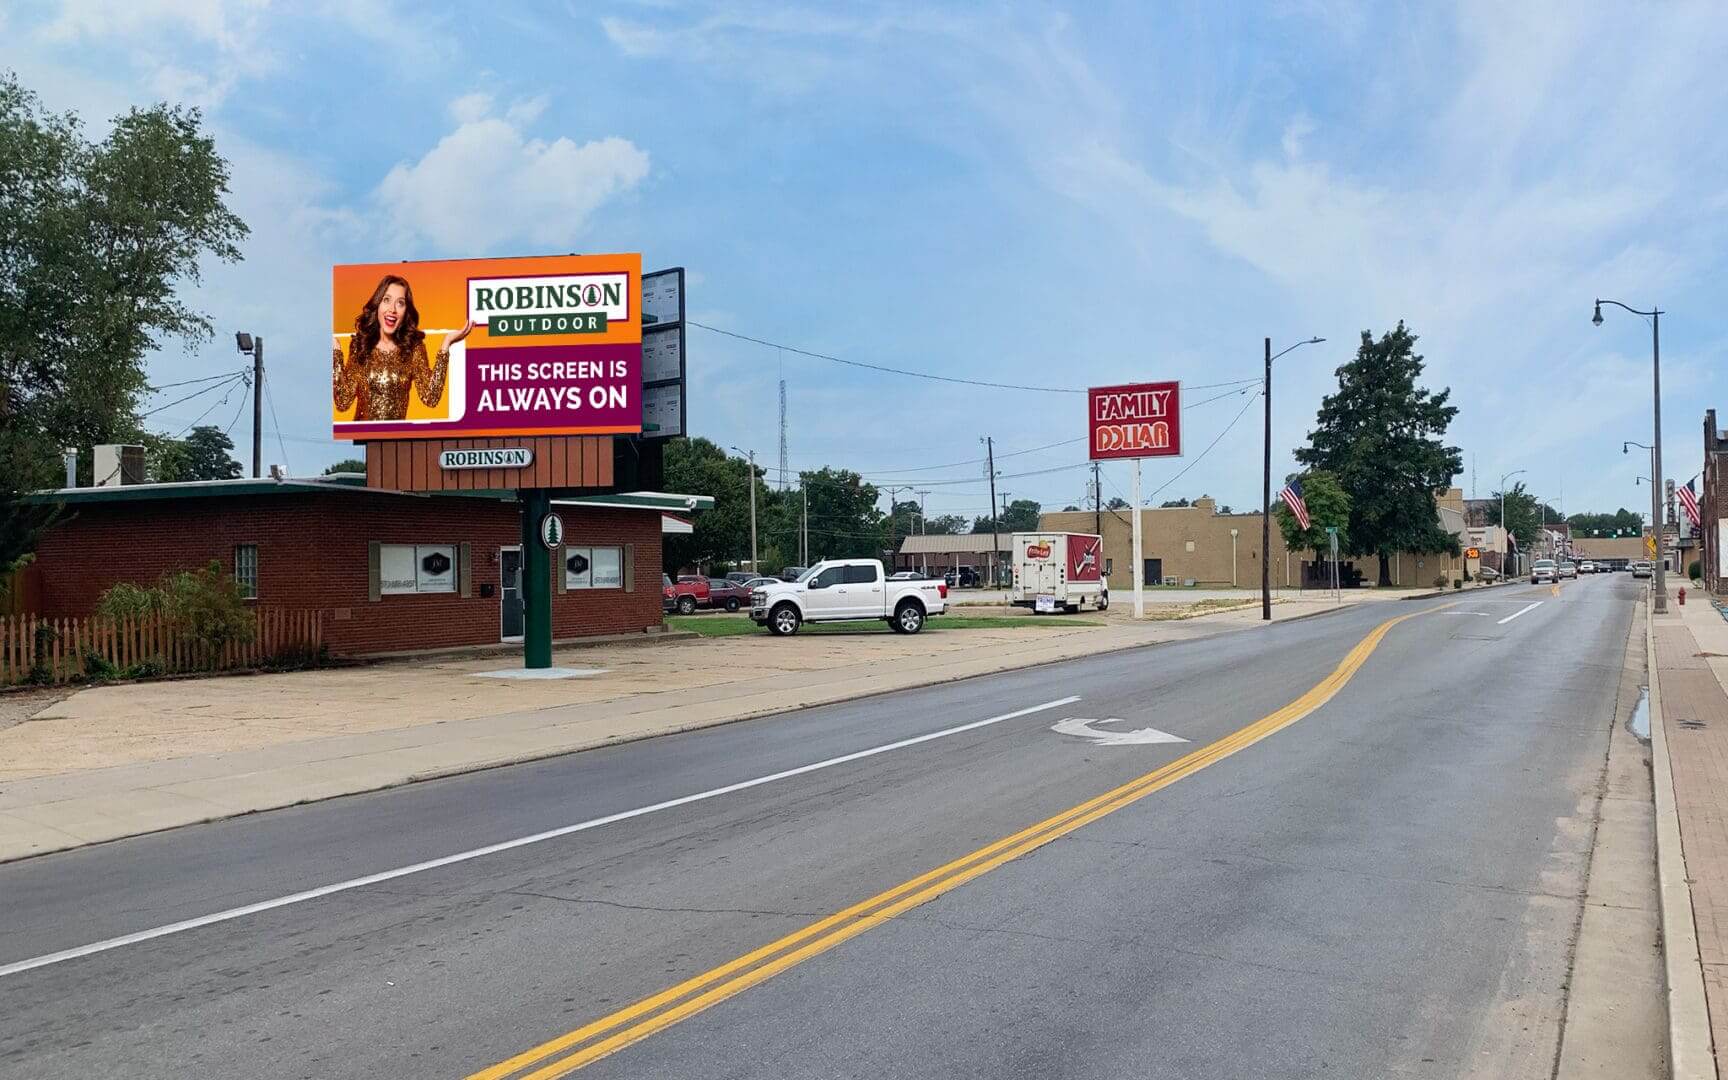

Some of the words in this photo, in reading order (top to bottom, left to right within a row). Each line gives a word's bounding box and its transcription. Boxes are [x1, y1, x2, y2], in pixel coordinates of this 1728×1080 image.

[475, 283, 621, 311] ROBINSON
[498, 316, 597, 332] OUTDOOR
[478, 363, 522, 382] THIS
[527, 361, 603, 380] SCREEN
[610, 360, 627, 378] IS
[477, 387, 582, 412] ALWAYS
[589, 385, 627, 409] ON
[1095, 390, 1171, 421] FAMILY
[1096, 421, 1169, 451] DOLLAR
[445, 451, 525, 466] ROBINSON
